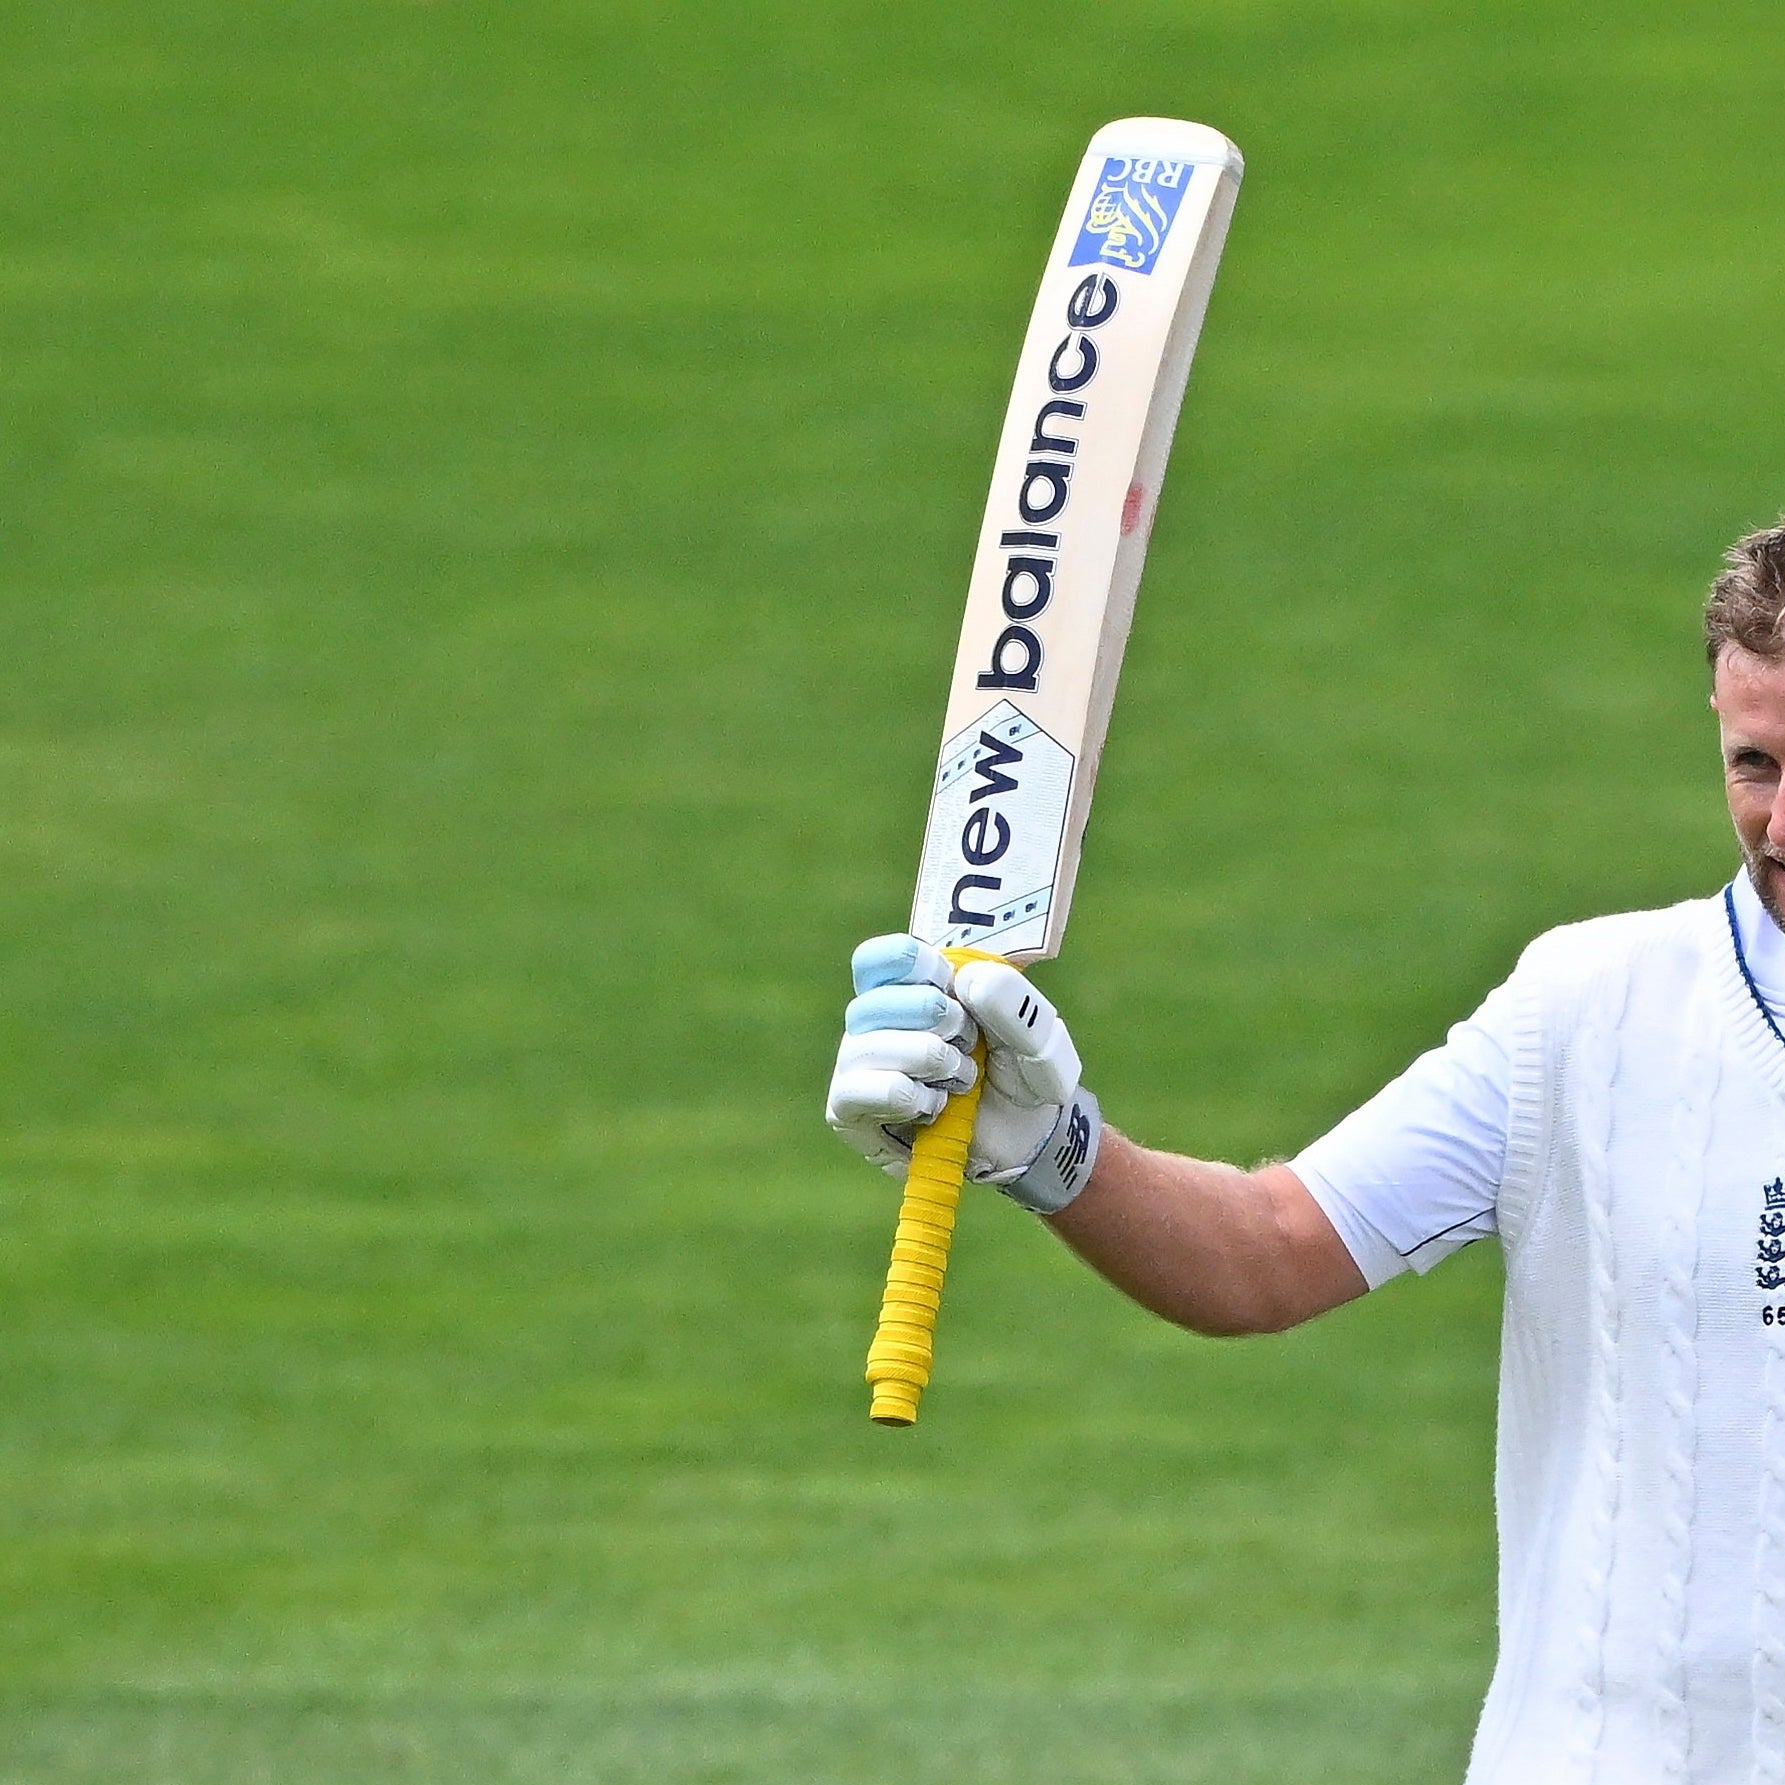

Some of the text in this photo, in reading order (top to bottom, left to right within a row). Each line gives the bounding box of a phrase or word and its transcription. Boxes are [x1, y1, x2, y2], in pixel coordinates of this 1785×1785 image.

[1106, 157, 1185, 189] RBC
[975, 272, 1120, 694] balance
[947, 730, 1024, 928] new
